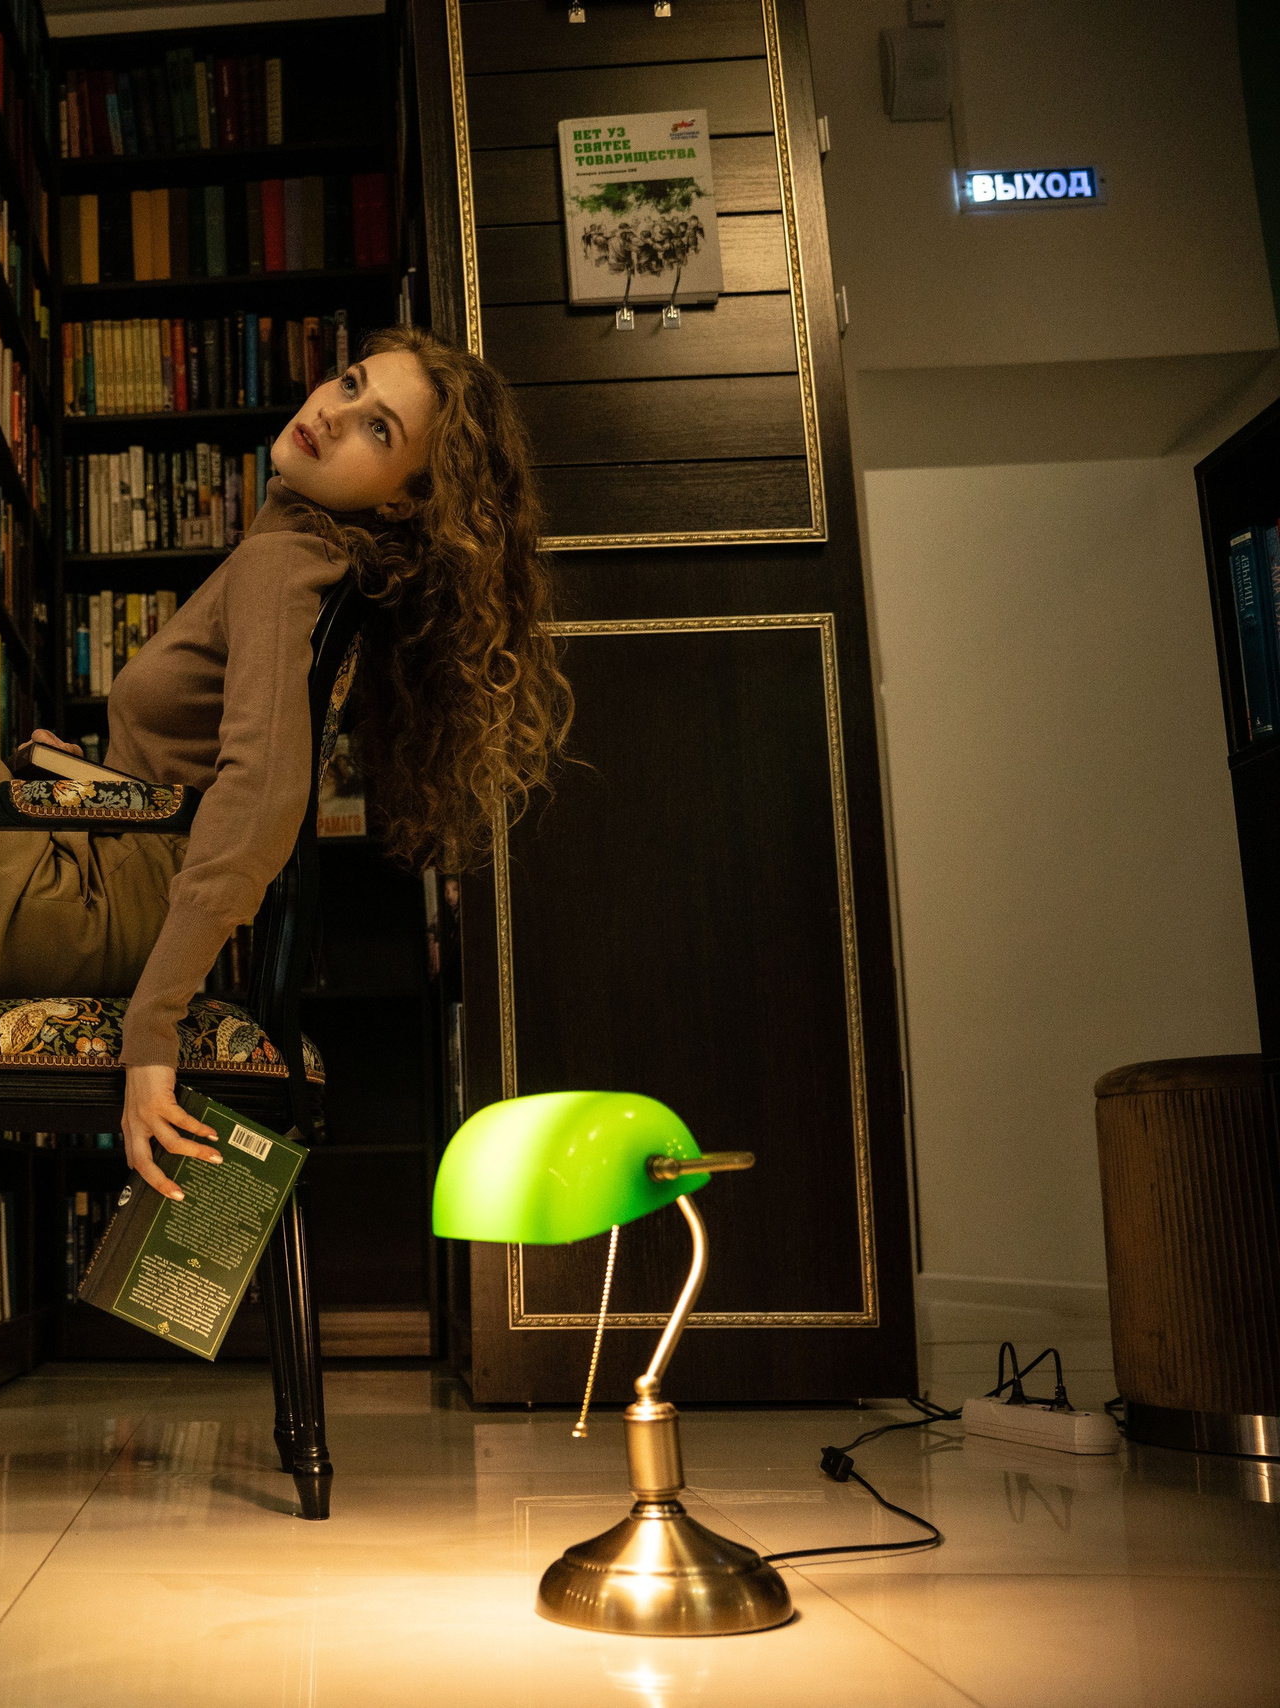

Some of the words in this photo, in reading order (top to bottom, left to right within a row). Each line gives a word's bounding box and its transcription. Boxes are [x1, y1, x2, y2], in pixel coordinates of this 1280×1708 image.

[573, 128, 602, 141] НЕТ
[608, 127, 625, 139] УЗ
[574, 139, 631, 154] СВЯТЕЕ
[575, 147, 697, 167] ТОВАРИЩЕСТВА
[972, 171, 1092, 202] ВЫХОД
[1240, 554, 1254, 606] ПИЛЧЕР
